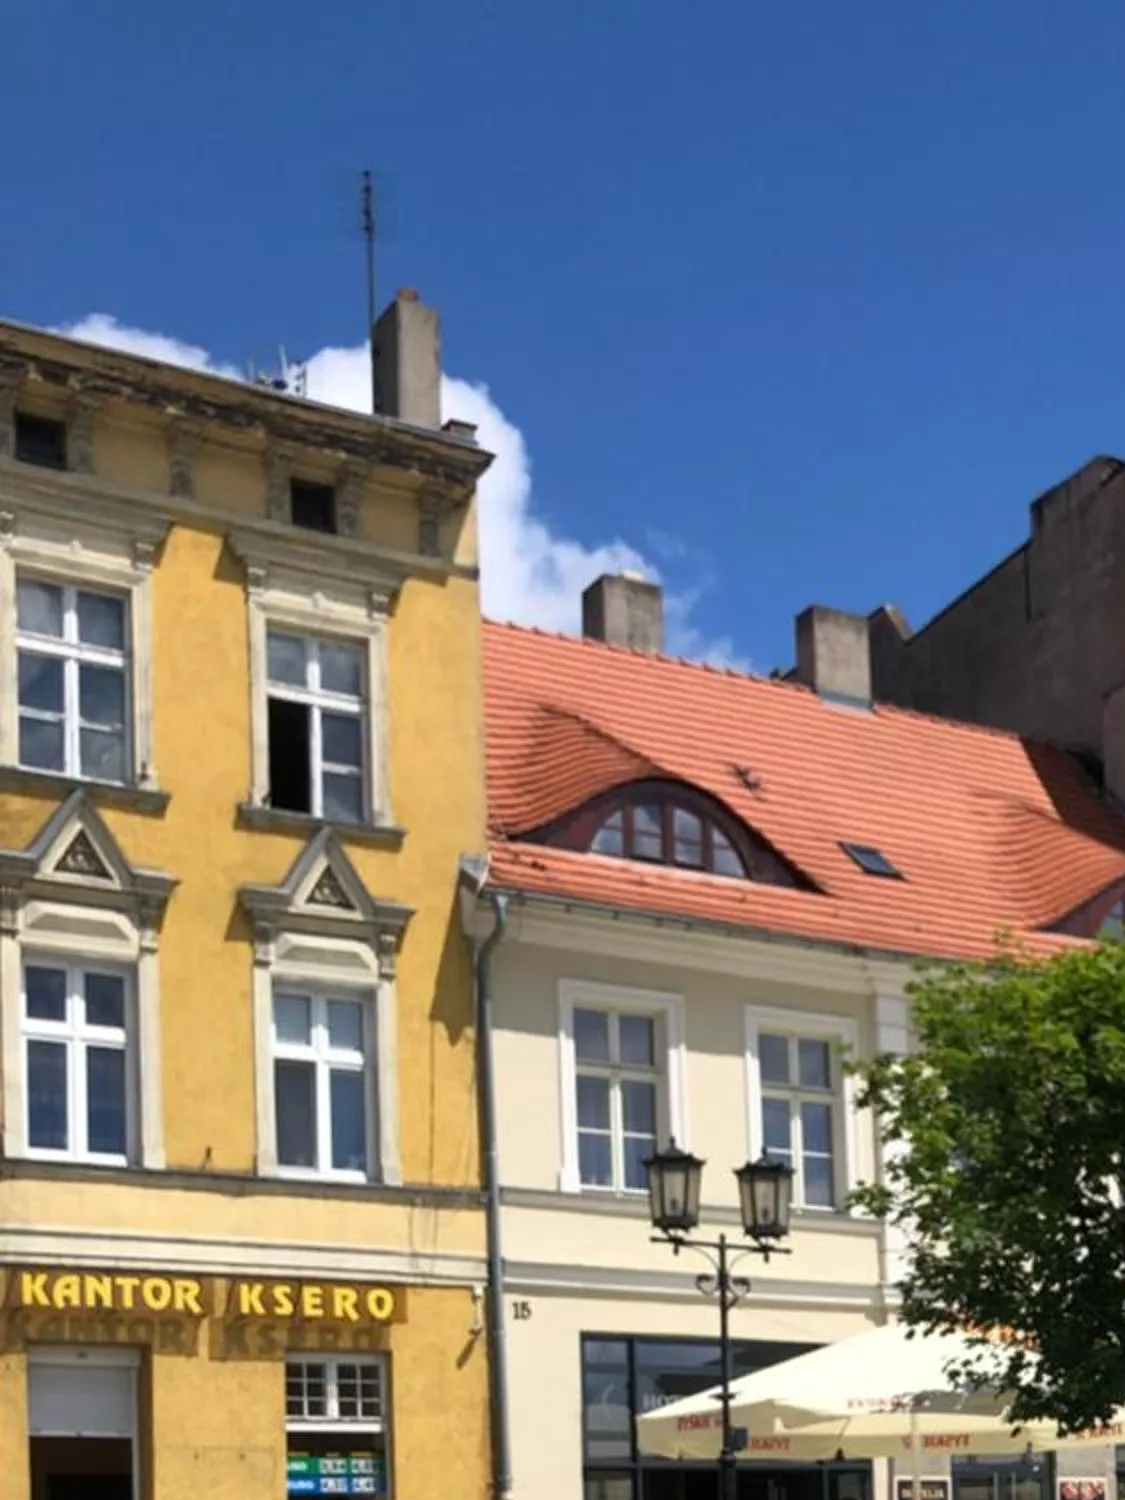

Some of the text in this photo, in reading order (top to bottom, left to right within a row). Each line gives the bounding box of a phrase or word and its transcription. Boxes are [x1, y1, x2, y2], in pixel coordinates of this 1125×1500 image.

[21, 1273, 394, 1321] KANTOR KSERO
[512, 1301, 532, 1320] 15
